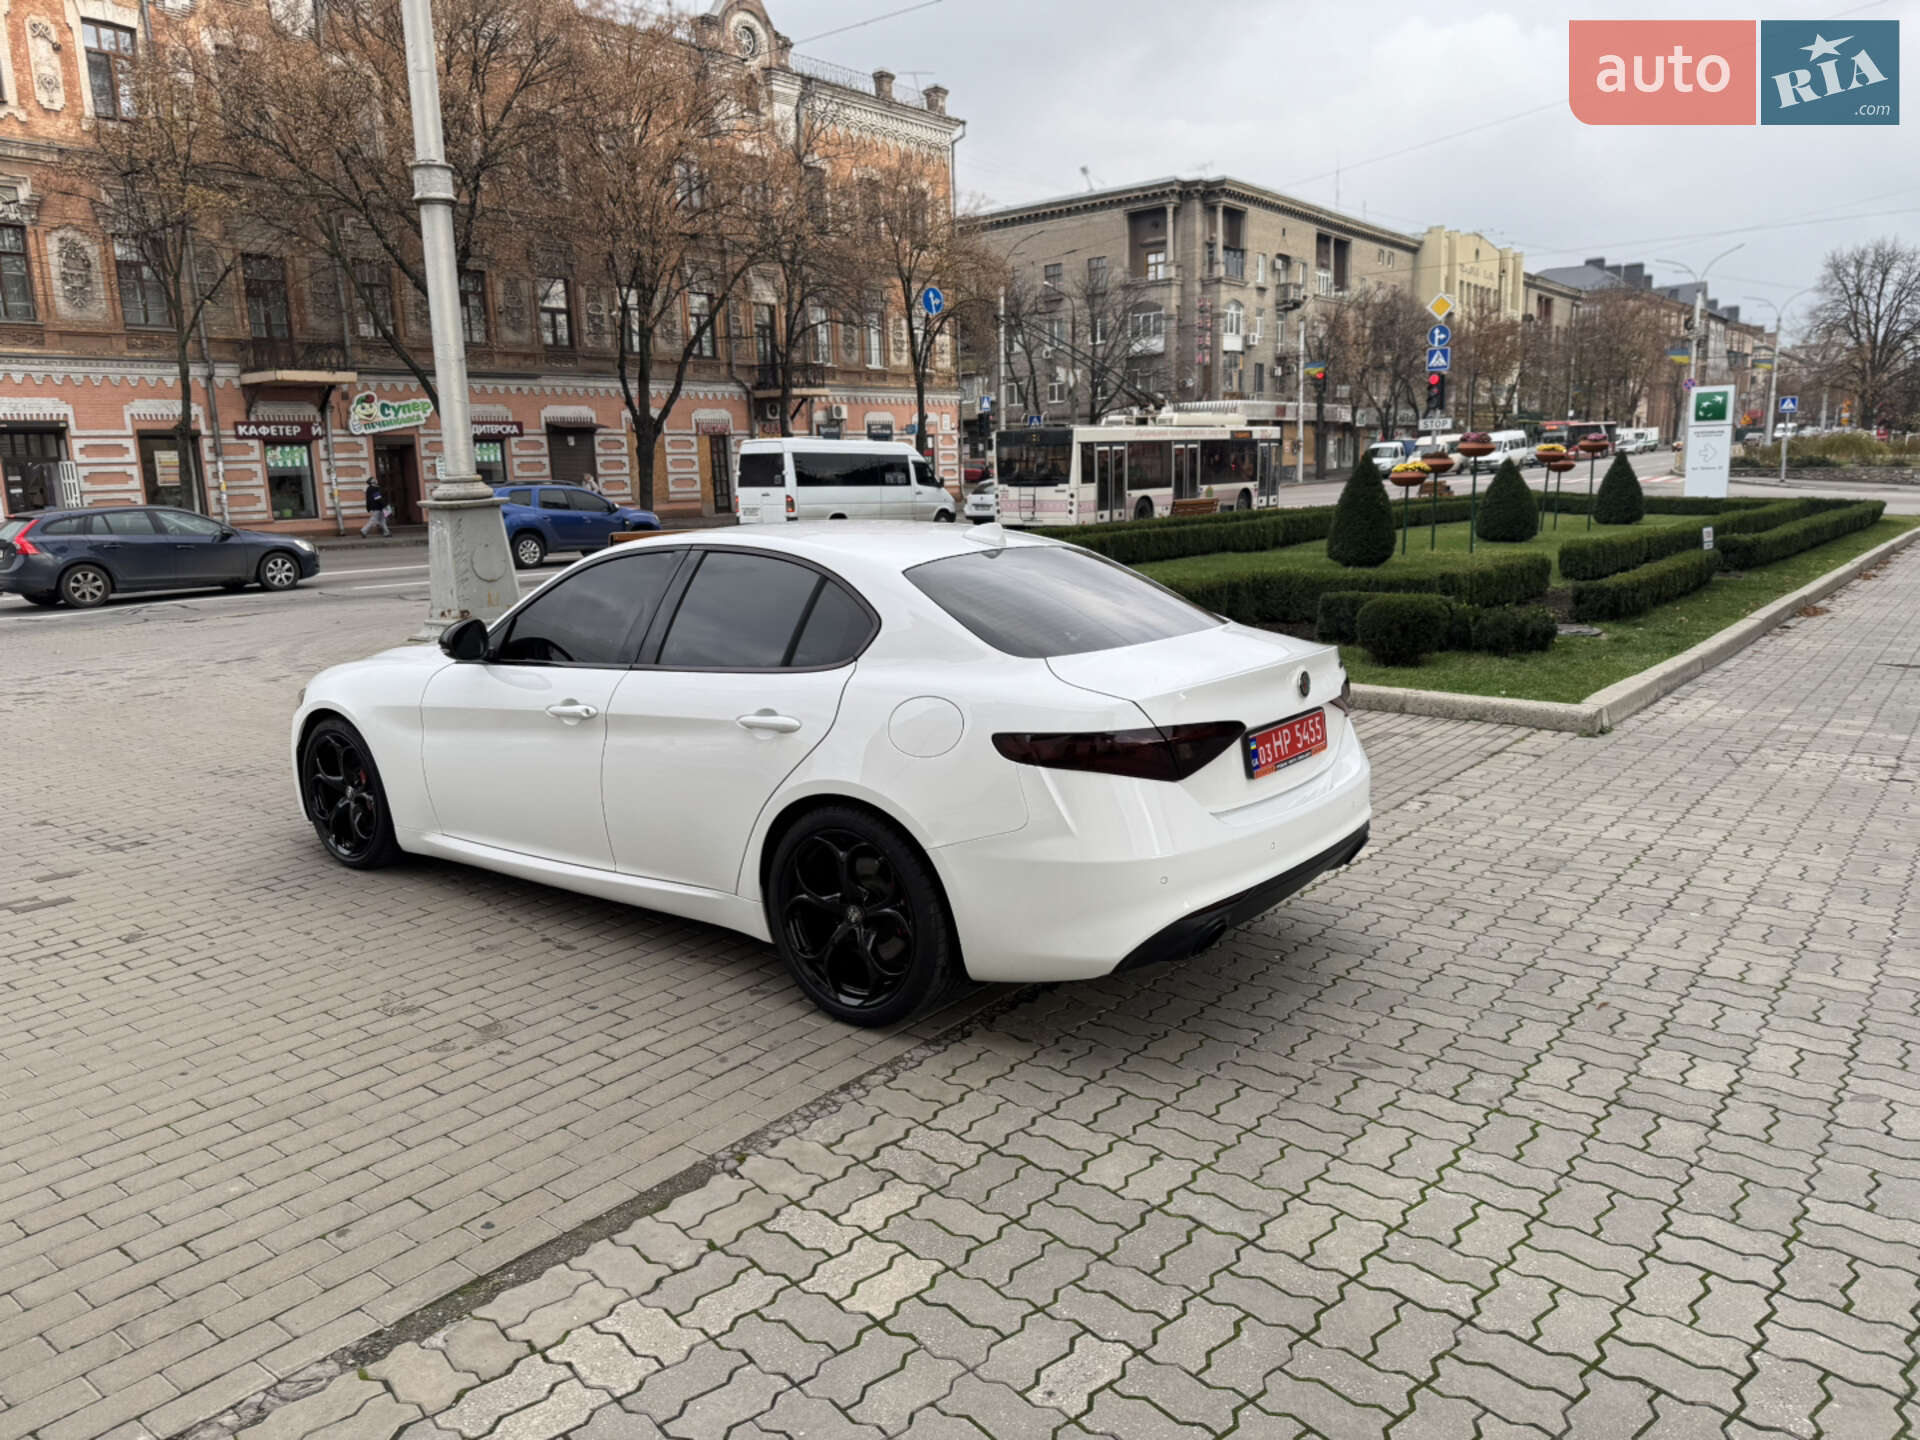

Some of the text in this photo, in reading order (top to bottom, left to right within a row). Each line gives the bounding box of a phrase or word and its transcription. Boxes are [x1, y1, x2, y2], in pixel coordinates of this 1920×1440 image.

[472, 424, 519, 435] ДИТЕРСКА
[1423, 420, 1448, 429] STOP
[1294, 716, 1323, 749] 5455
